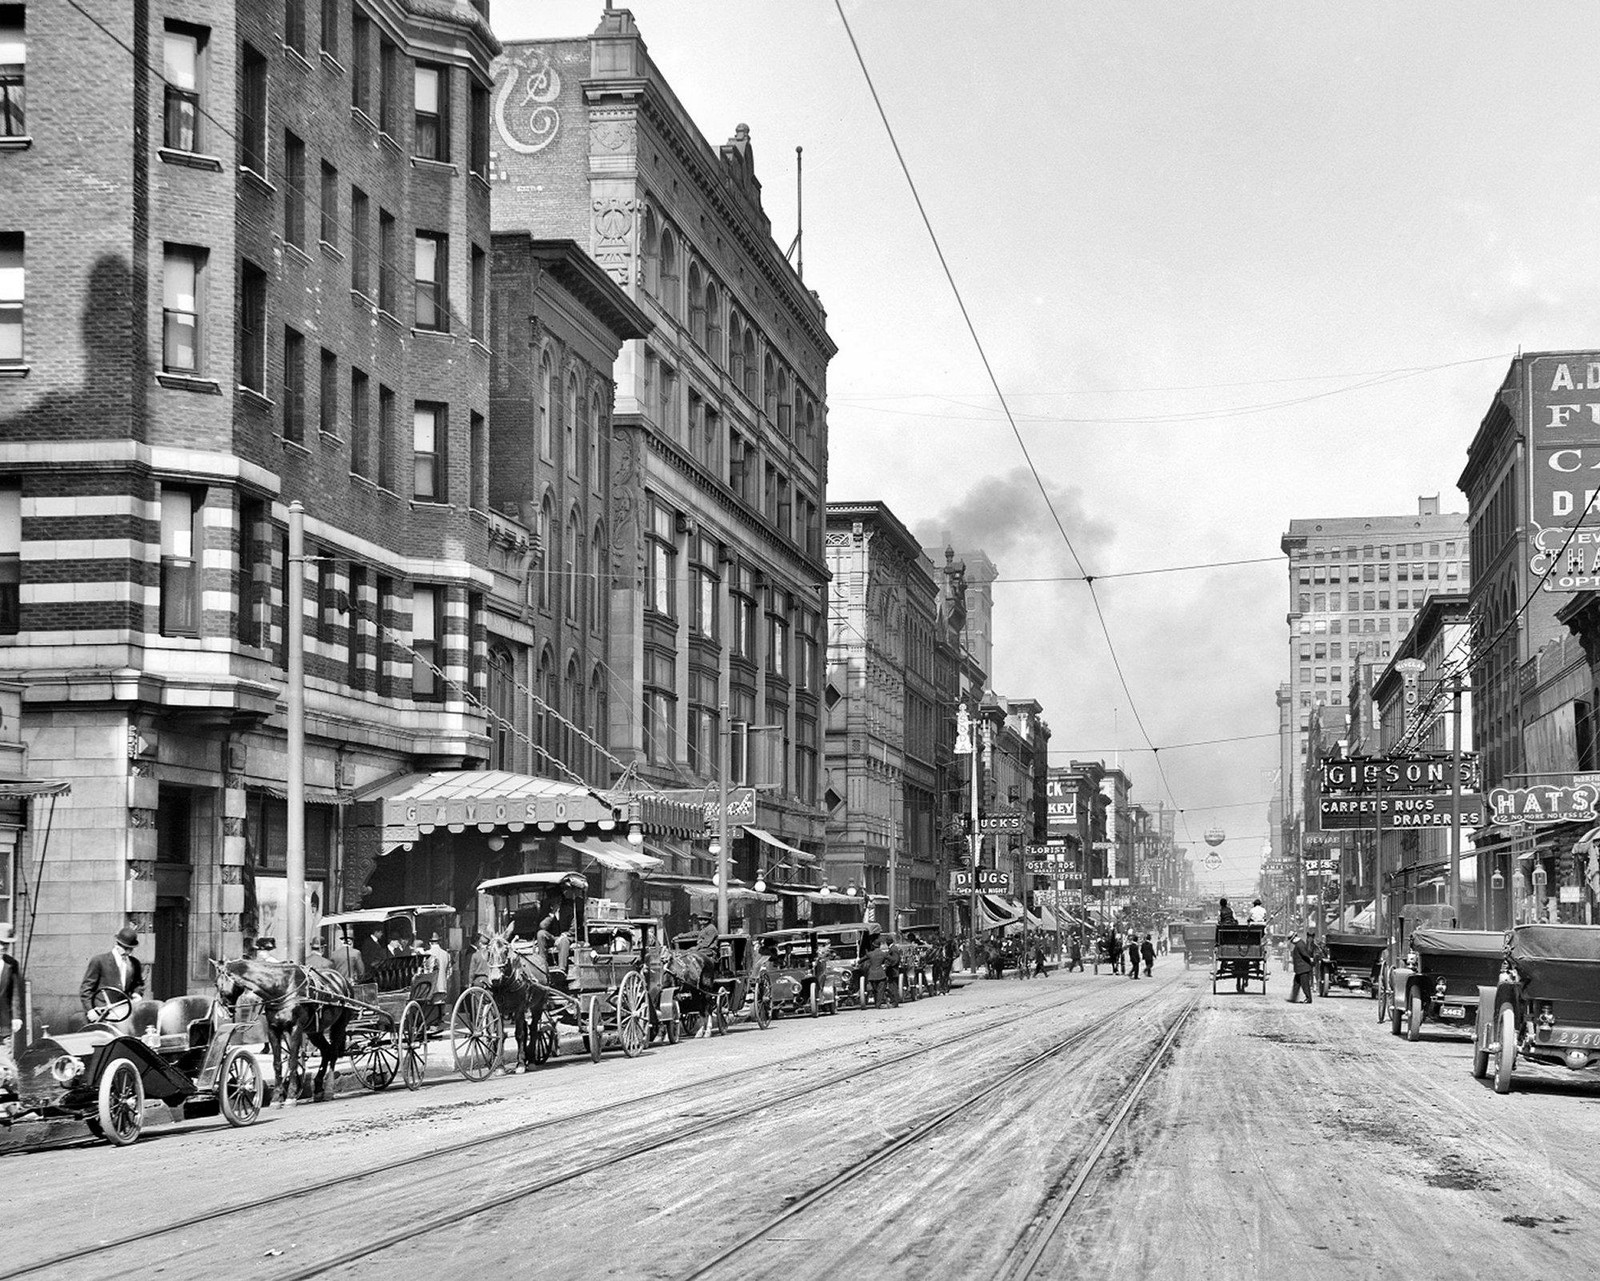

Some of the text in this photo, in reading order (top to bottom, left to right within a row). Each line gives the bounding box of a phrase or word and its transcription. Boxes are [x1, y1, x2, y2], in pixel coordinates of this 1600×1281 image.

[1329, 763, 1471, 784] GIBSON'S
[1321, 800, 1435, 812] CARPETS RUGS
[1497, 790, 1588, 814] HATS
[406, 802, 566, 821] GAYOSO
[1393, 813, 1479, 825] DRAPERES
[1047, 862, 1075, 870] CRDS
